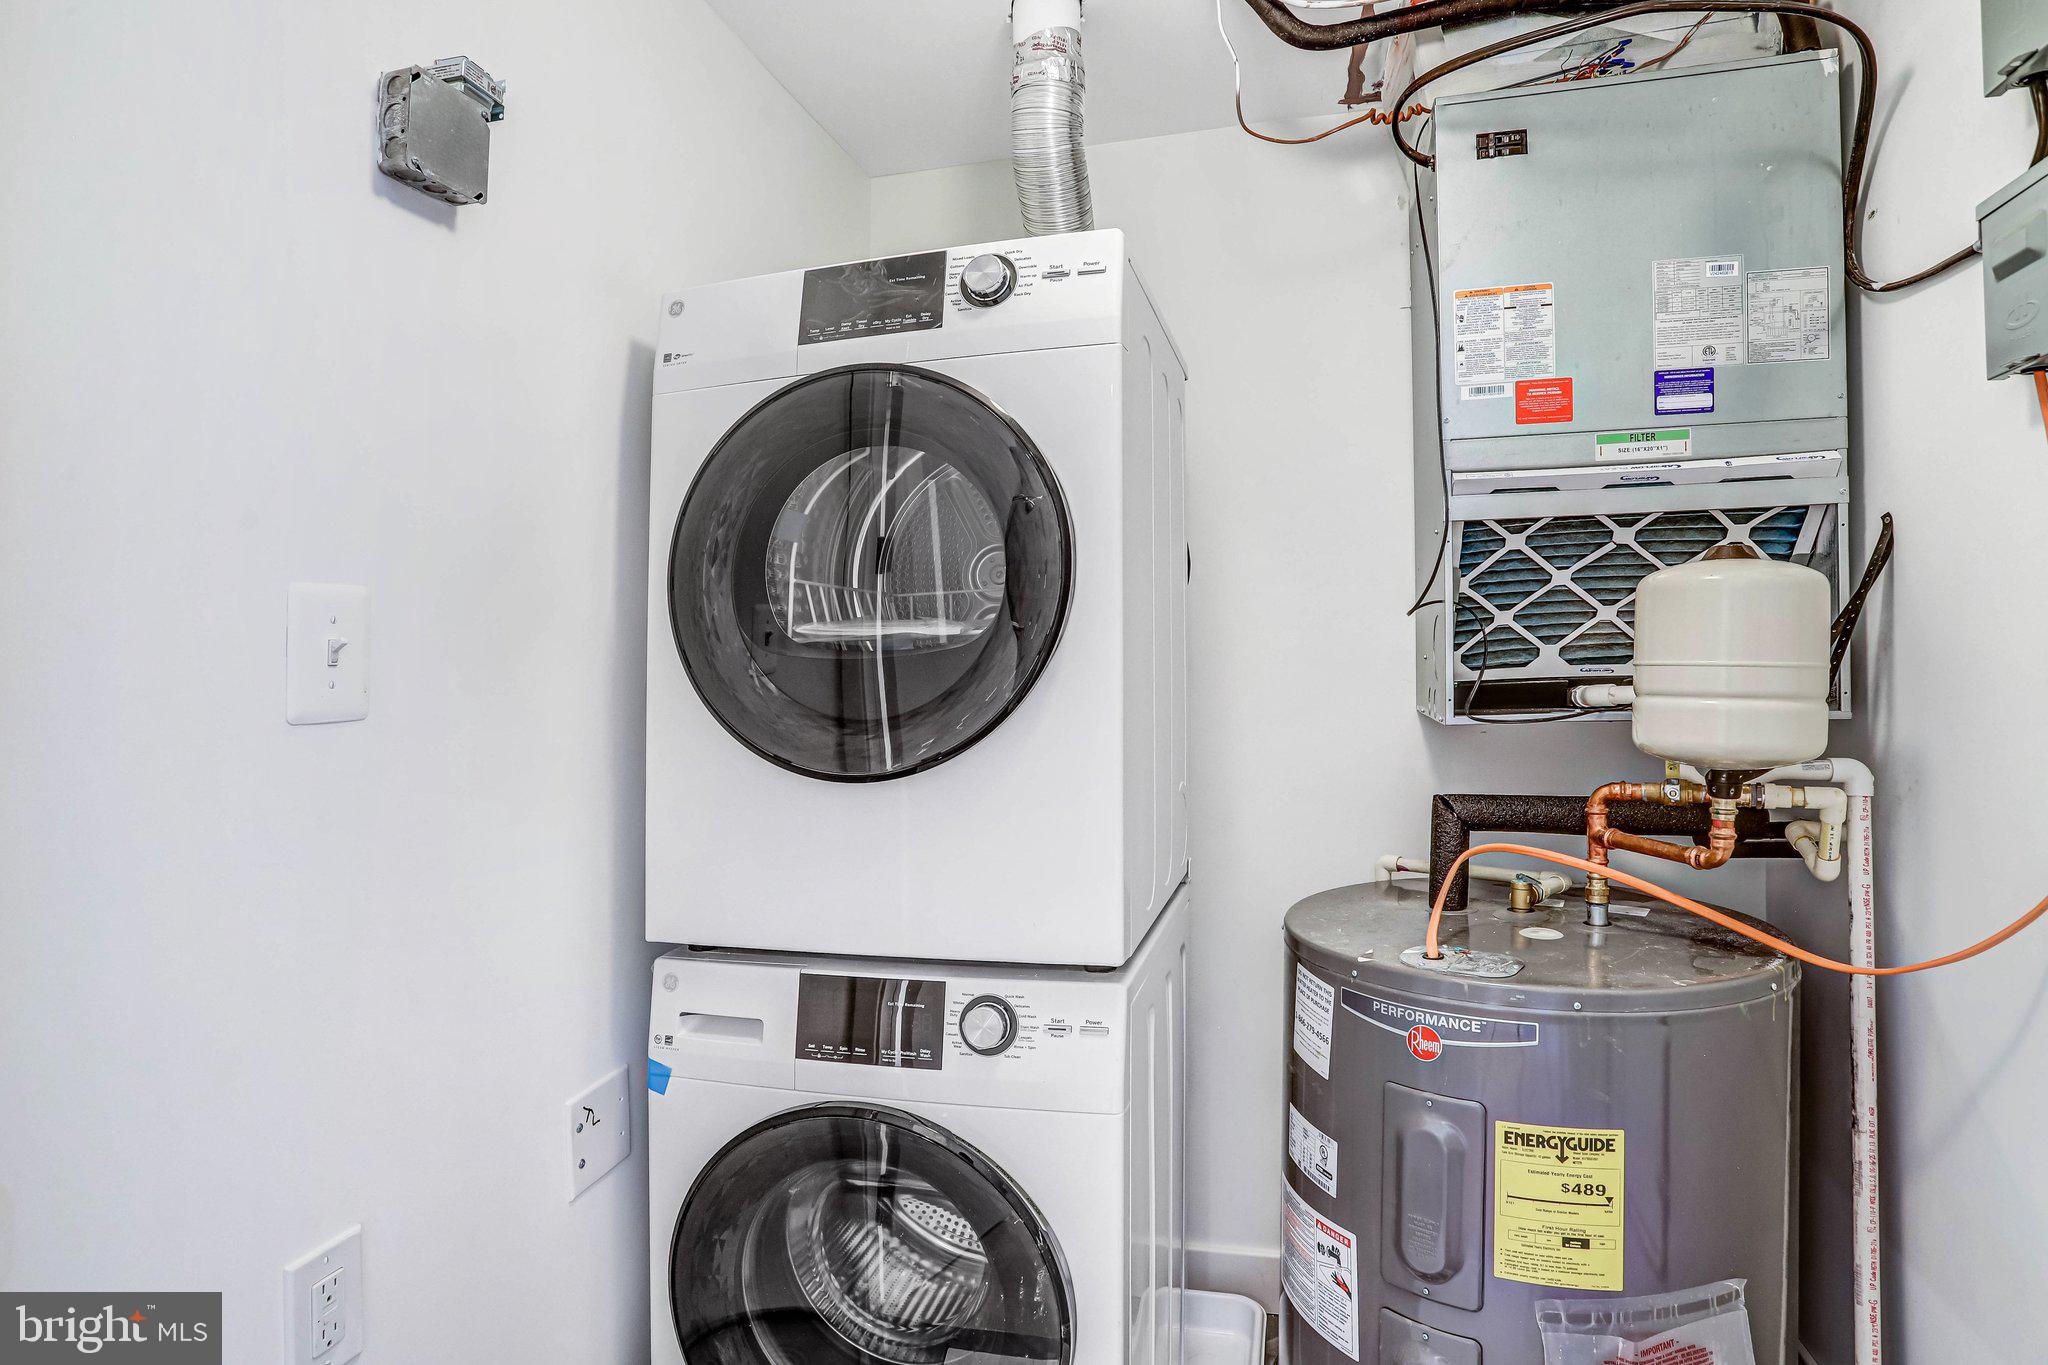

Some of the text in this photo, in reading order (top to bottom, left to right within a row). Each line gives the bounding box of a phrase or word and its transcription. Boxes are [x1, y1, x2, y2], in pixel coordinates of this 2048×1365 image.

[1630, 432, 1656, 442] FILTER
[1308, 976, 1322, 992] RETURN
[1323, 986, 1332, 998] THIS
[1308, 984, 1319, 998] HEATER
[1310, 996, 1330, 1014] PURCHASE
[1411, 1026, 1440, 1054] Rheem
[1504, 1131, 1616, 1152] ENERGYGUIDE
[1561, 1183, 1606, 1196] $489
[1322, 1225, 1348, 1246] DANGER
[1640, 1339, 1675, 1358] IMPORTANT
